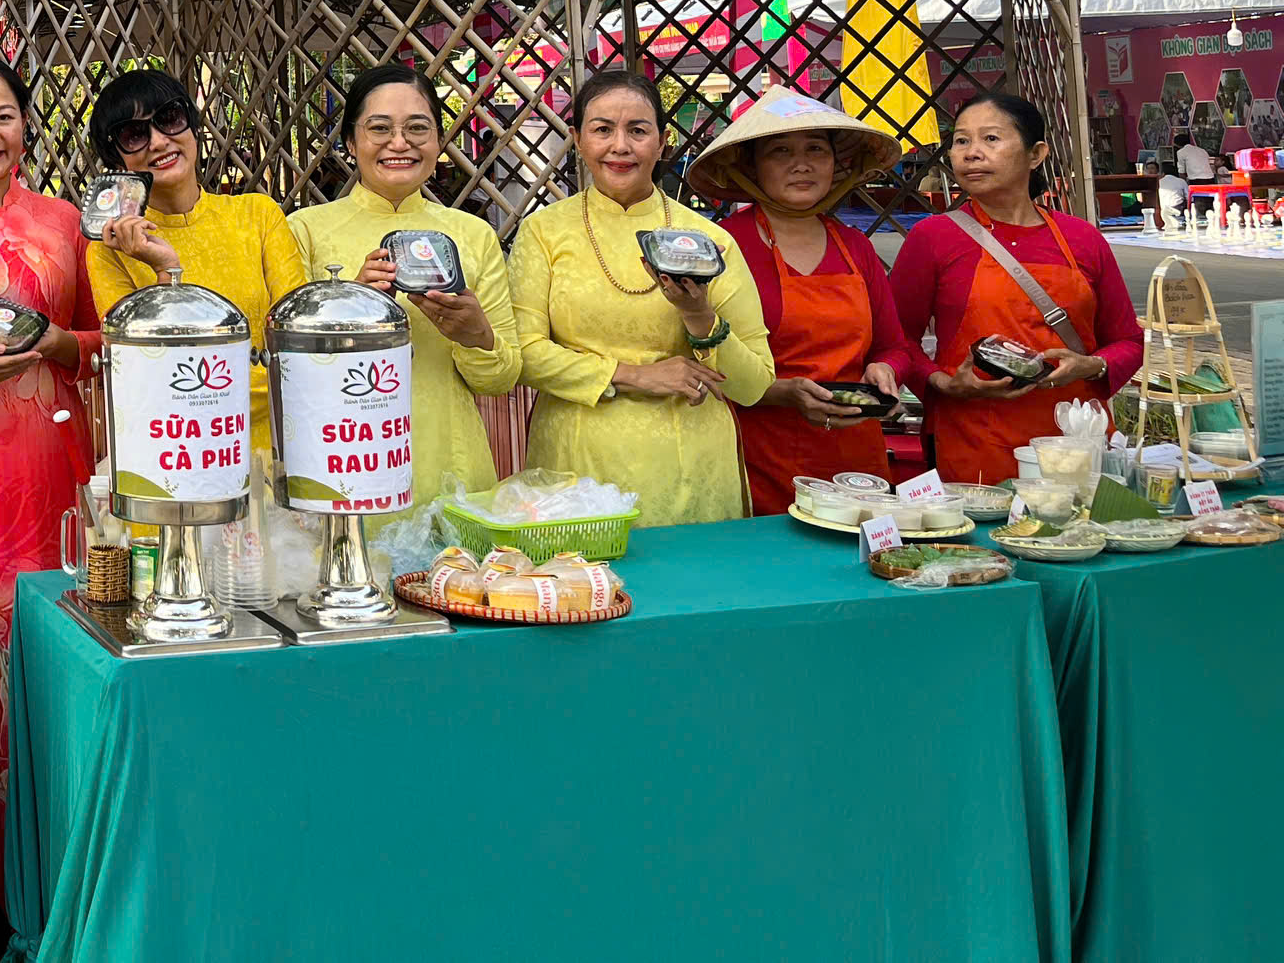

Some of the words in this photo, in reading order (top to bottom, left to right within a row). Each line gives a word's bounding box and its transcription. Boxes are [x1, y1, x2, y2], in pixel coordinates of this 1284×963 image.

[1162, 34, 1193, 56] KHÔNG
[1197, 36, 1220, 53] GIAN
[1245, 28, 1272, 50] SÁCH
[149, 414, 201, 439] SỮA
[210, 413, 245, 436] SEN
[322, 418, 373, 443] SỮA
[381, 414, 411, 439] SEN
[158, 443, 192, 471] CÀ
[202, 440, 242, 469] PHÊ
[327, 453, 379, 474] RAU
[387, 438, 411, 469] MÁ
